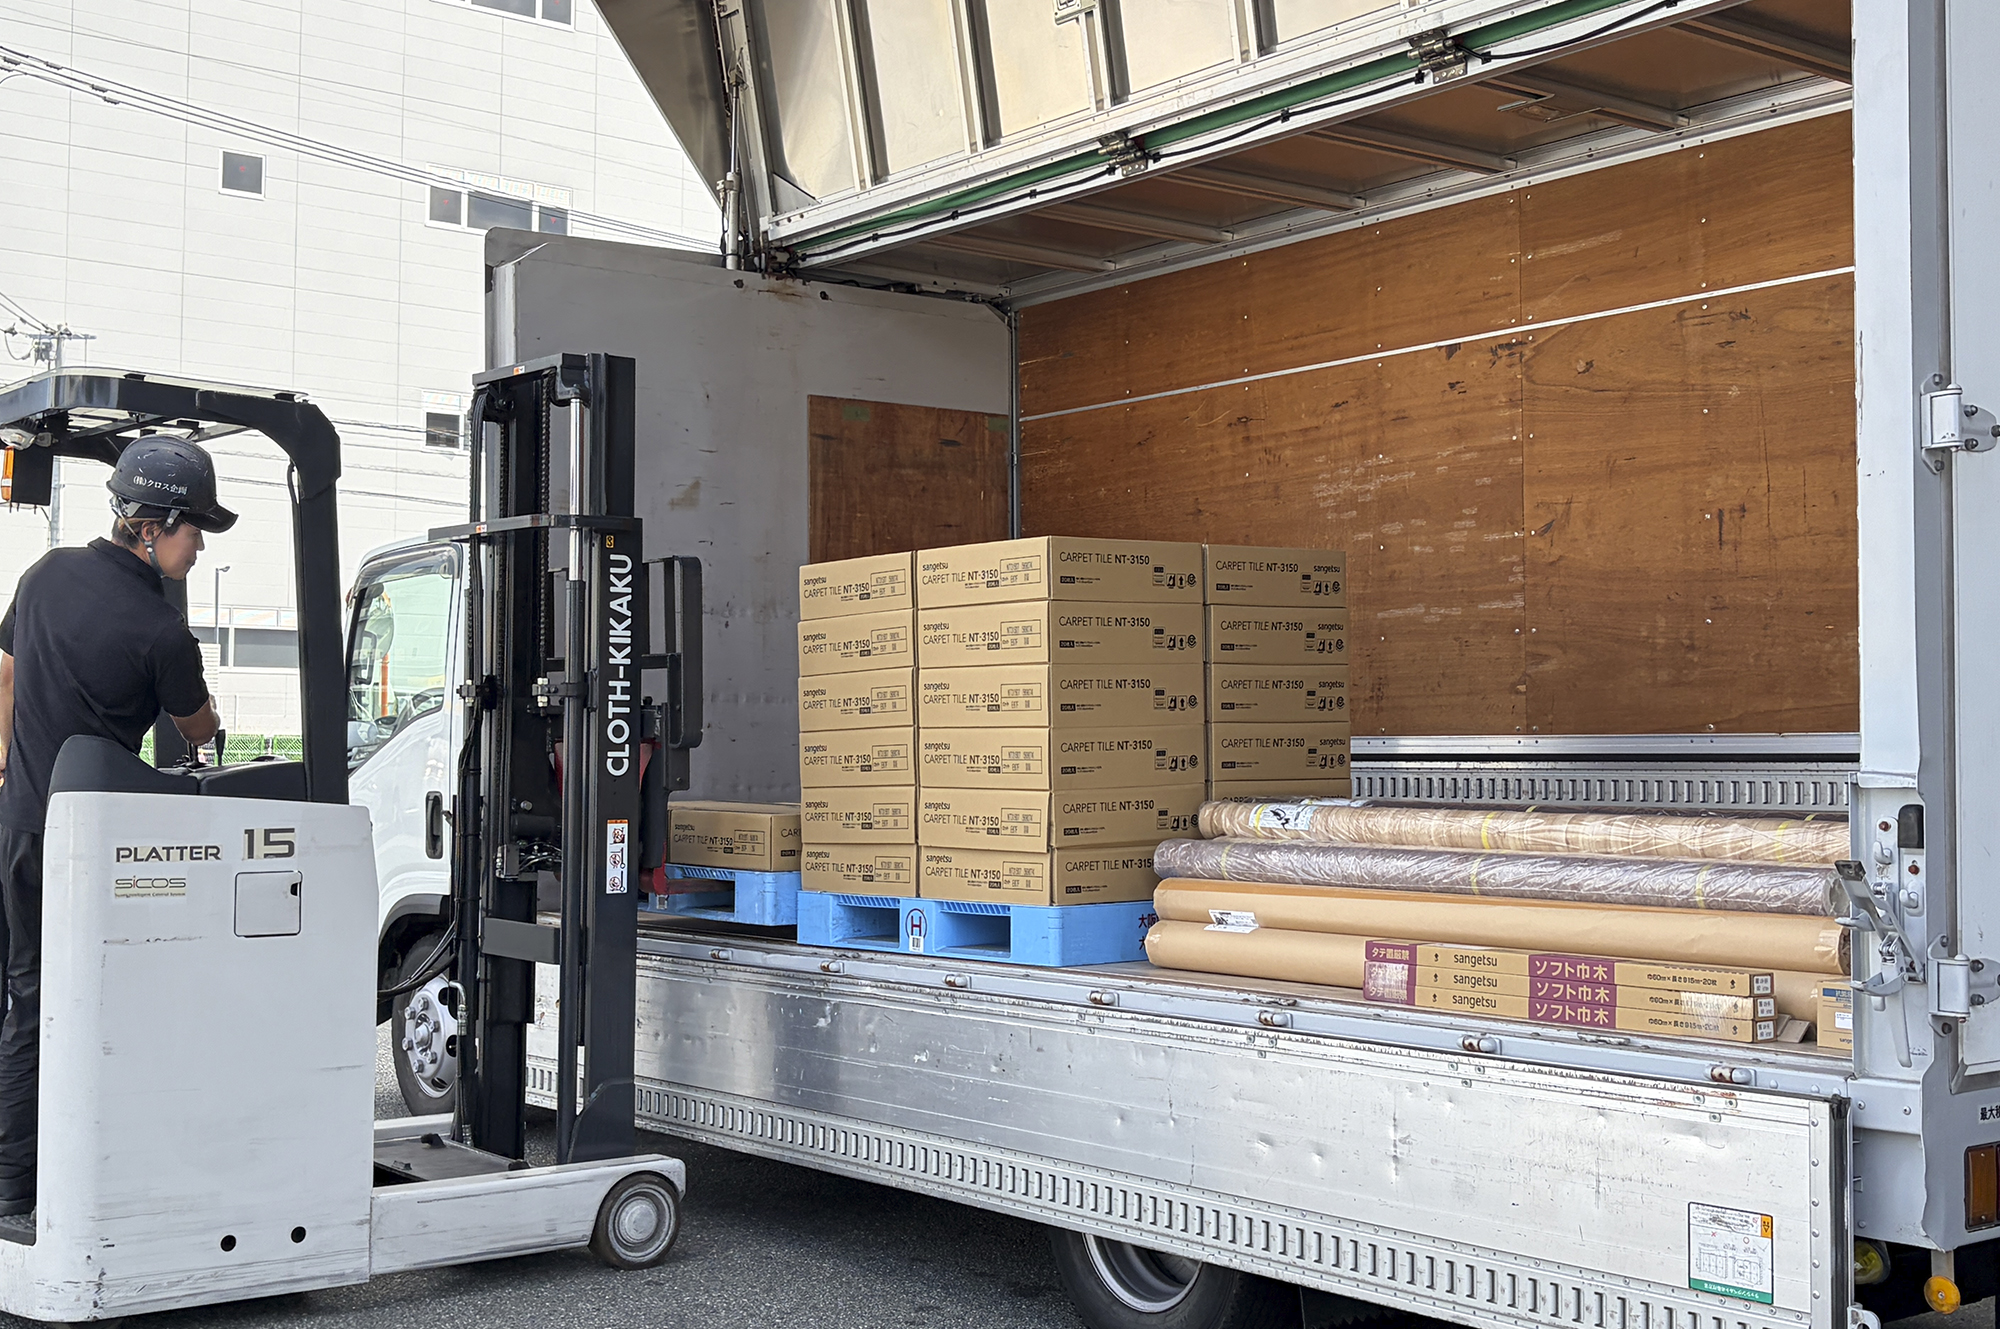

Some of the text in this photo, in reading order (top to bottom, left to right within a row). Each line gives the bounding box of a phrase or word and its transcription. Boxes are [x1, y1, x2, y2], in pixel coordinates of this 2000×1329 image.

[1060, 552, 1150, 565] CARPET TILE NT-3150
[922, 561, 948, 572] sangetsu
[1216, 560, 1298, 572] CARPET TILE NT-3150
[1314, 564, 1340, 574] sangetsu
[804, 576, 826, 586] sangetsu
[922, 574, 951, 585] CARPET
[952, 572, 966, 582] TILE
[967, 569, 998, 581] NT-3150
[803, 586, 828, 599] CARPET
[829, 586, 842, 595] TILE
[843, 582, 869, 594] NT-3150
[923, 622, 949, 632] sangetsu
[1059, 616, 1150, 627] CARPET TILE NT-3150
[1221, 621, 1303, 631] CARPET TILE NT-3150
[1318, 623, 1344, 632] sangetsu
[803, 633, 826, 642] sangetsu
[923, 634, 950, 644] CARPET
[953, 633, 966, 643] TILE
[969, 631, 999, 642] NT-3150
[803, 644, 827, 654] CARPET
[829, 642, 841, 652] TILE
[842, 639, 870, 650] NT-3150
[606, 554, 632, 776] CLOTH-KIKAKU
[924, 682, 949, 692] sangetsu
[1060, 679, 1150, 690] CARPET TILE NT-3150
[1221, 680, 1304, 689] CARPET TILE NT-3150
[1318, 681, 1344, 690] sangetsu
[803, 688, 826, 698] sangetsu
[923, 694, 950, 704] CARPET
[953, 694, 967, 704] TILE
[969, 693, 999, 703] NT-3150
[803, 700, 827, 710] CARPET
[829, 699, 841, 708] TILE
[842, 697, 870, 707] NT-3150
[924, 742, 950, 752] sangetsu
[1061, 740, 1152, 752] CARPET TILE NT-3150
[1221, 738, 1304, 748] CARPET TILE NT-3150
[1319, 738, 1345, 748] sangetsu
[804, 745, 827, 754] sangetsu
[804, 756, 828, 765] CARPET
[830, 755, 842, 764] TILE
[844, 754, 871, 764] NT-3150
[924, 754, 951, 764] CARPET
[953, 754, 967, 764] TILE
[970, 755, 1000, 765] NT-3150
[805, 801, 828, 810] sangetsu
[924, 802, 950, 811] sangetsu
[1063, 800, 1154, 814] CARPET TILE NT-3150
[805, 812, 829, 821] CARPET
[831, 812, 843, 821] TILE
[845, 812, 872, 821] NT-3150
[924, 813, 951, 824] CARPET
[953, 814, 967, 825] TILE
[969, 816, 999, 826] NT-3150
[116, 828, 295, 862] PLATTER 15
[710, 837, 733, 846] NT-3150
[806, 851, 830, 860] sangetsu
[926, 855, 952, 864] sangetsu
[805, 862, 830, 871] CARPET
[832, 862, 844, 872] TILE
[846, 864, 873, 873] NT-3150
[1066, 859, 1154, 872] CARPET TILE NT-315
[926, 867, 953, 877] CARPET
[955, 868, 968, 878] TILE
[971, 869, 1000, 880] NT-3150
[1453, 952, 1498, 967] sangetsu
[1535, 960, 1608, 981] ソフト巾木
[1453, 972, 1498, 988] sangetsu
[1536, 982, 1609, 1003] ソフト巾木
[1452, 992, 1497, 1009] sangetsu
[1535, 1003, 1609, 1024] ソフト巾木
